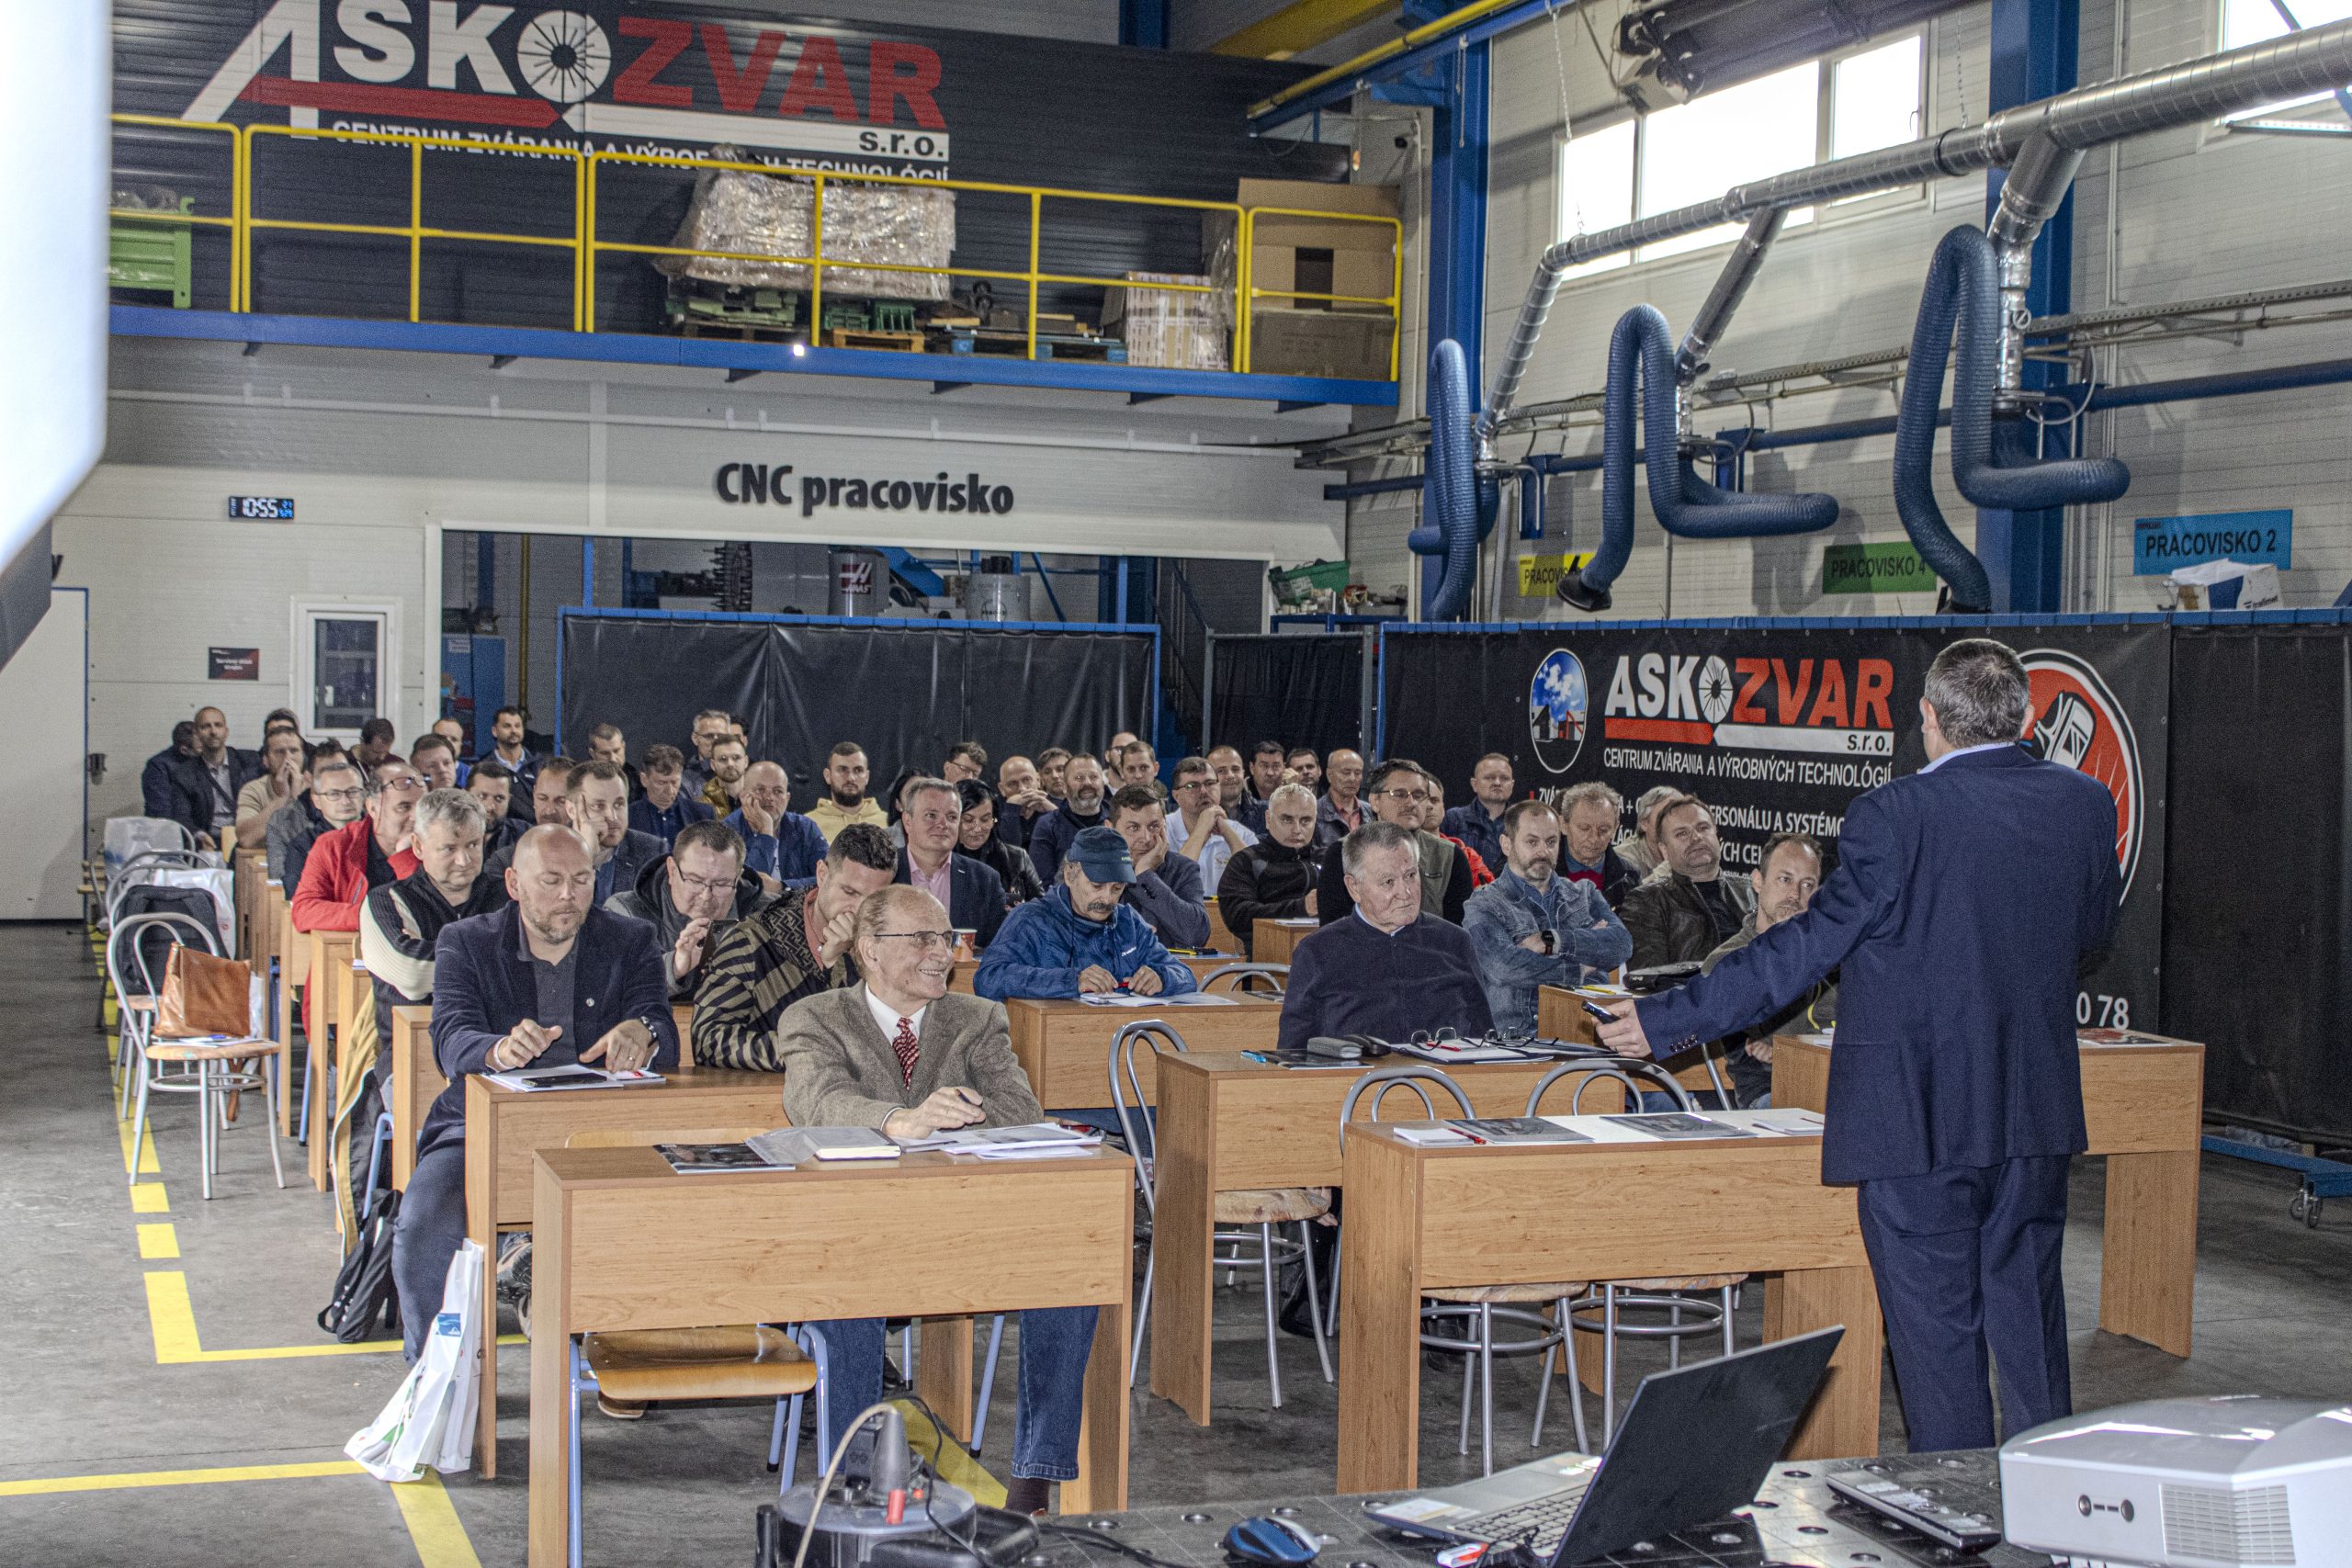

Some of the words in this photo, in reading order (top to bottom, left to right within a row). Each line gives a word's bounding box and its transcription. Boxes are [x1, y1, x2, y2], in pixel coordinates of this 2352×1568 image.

[332, 119, 460, 152] CENTRUM
[858, 130, 945, 157] s.r.o.
[717, 462, 793, 504] CNC
[801, 471, 1015, 518] pracovisko
[2145, 529, 2261, 558] PRACOVISKO
[2266, 529, 2277, 553] 2
[1831, 557, 1916, 579] PRACOVISKO
[1847, 734, 1890, 752] s.r.o.
[1603, 748, 1653, 771] CENTRUM
[1654, 752, 1704, 776] ZVÁRANIA
[1706, 756, 1716, 776] A
[1717, 754, 1793, 783] VÝROBNÝCH
[1798, 761, 1893, 788] TECHNOLÓGIÍ
[1773, 811, 1783, 832] A
